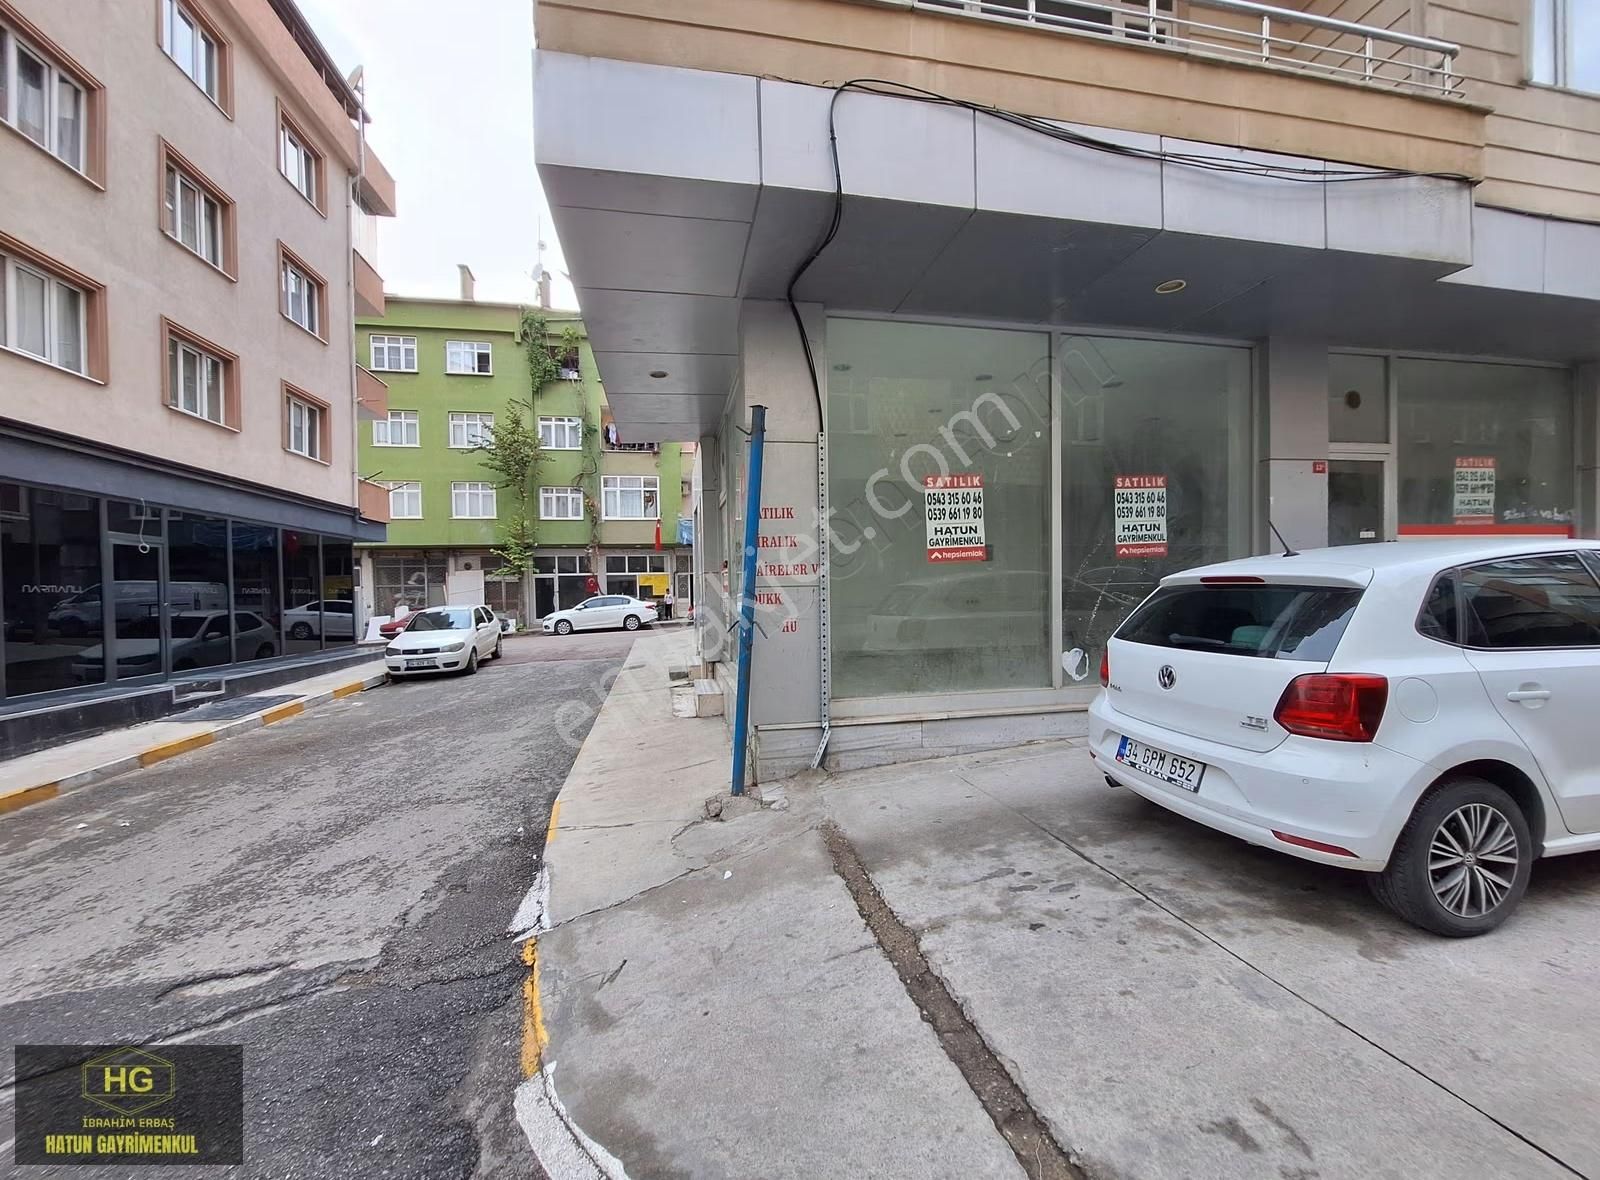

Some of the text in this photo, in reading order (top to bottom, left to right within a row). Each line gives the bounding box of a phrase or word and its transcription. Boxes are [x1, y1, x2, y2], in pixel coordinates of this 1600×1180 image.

[927, 476, 981, 487] SATILIK
[1116, 477, 1165, 488] SATILIK
[927, 491, 982, 506] 0543 315 60 46
[1116, 492, 1133, 504] 0543
[1134, 492, 1145, 504] 315
[1146, 491, 1156, 504] 60
[759, 507, 794, 520] TILIK
[927, 506, 982, 521] 0539 661 19 80
[1116, 505, 1166, 518] 0539 661 19 80
[934, 525, 978, 536] HATUN
[1122, 523, 1161, 533] HATUN
[757, 533, 797, 549] İRALIK
[929, 535, 984, 547] GAYRİMENKUL
[756, 561, 808, 577] AİRELER
[1125, 742, 1138, 761] 34
[1169, 758, 1196, 782] 652
